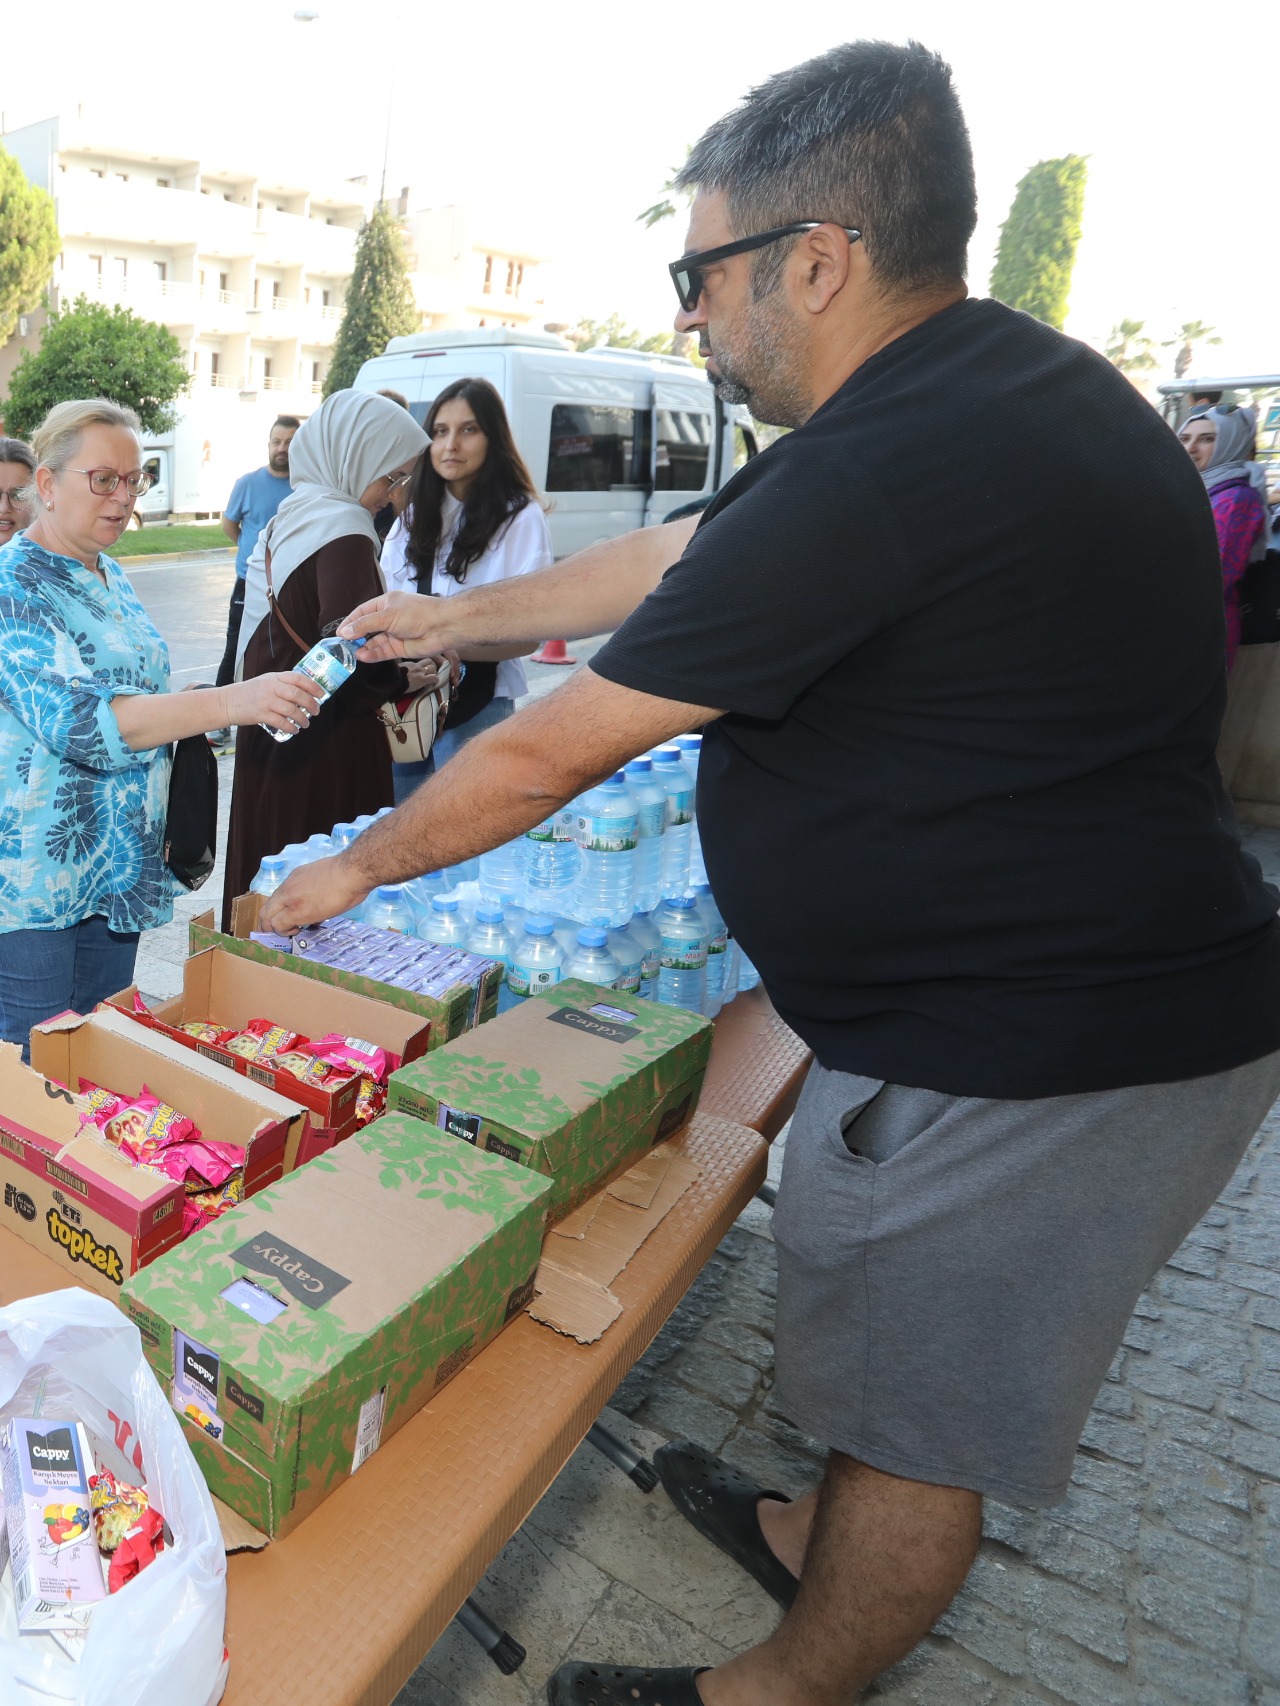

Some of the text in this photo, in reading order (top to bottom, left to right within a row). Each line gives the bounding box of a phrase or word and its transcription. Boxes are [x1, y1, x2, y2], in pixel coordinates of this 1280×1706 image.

[564, 1013, 623, 1037] Cappy
[448, 1121, 474, 1141] Cappy
[490, 1140, 515, 1158] Cappy
[46, 1207, 123, 1285] topkek
[254, 1246, 324, 1293] Cappy
[187, 1356, 215, 1384] Cappy
[230, 1386, 260, 1412] Cappy
[32, 1446, 70, 1461] Cappy
[57, 1471, 78, 1479] Meyve
